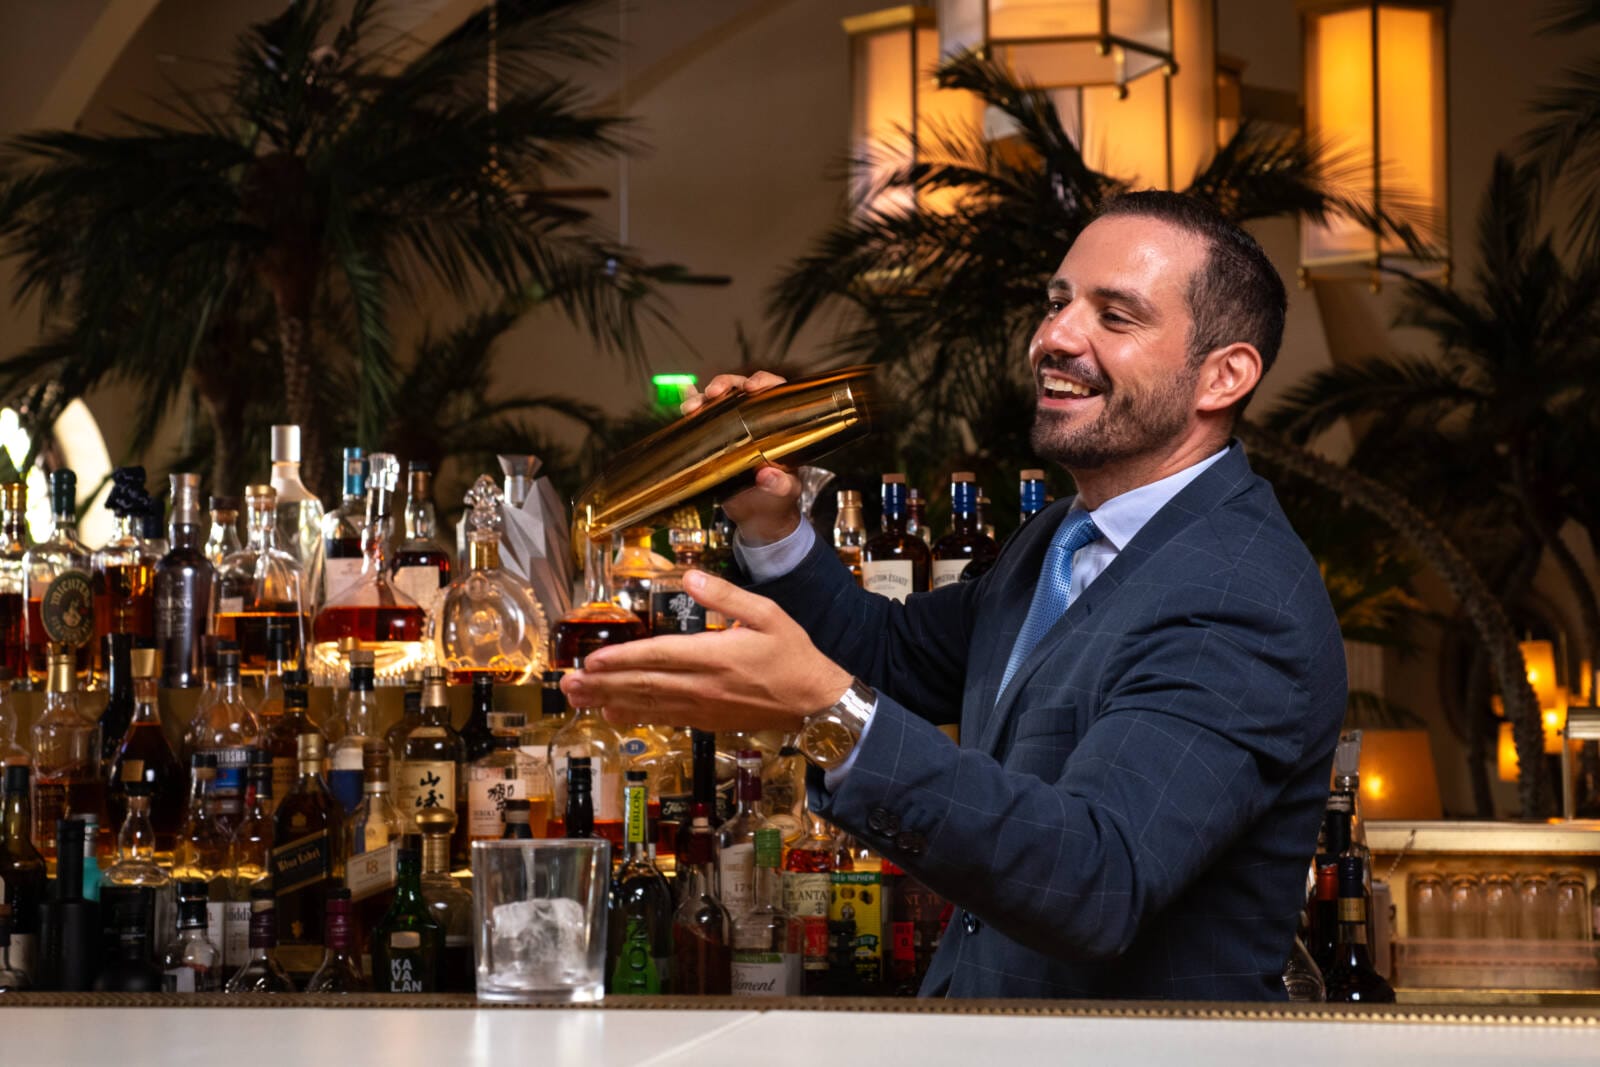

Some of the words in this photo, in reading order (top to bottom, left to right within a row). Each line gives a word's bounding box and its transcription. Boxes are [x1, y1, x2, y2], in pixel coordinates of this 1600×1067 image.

[632, 791, 641, 836] LEBLON
[390, 958, 413, 970] KA
[391, 970, 413, 982] VA
[390, 980, 423, 993] LAN
